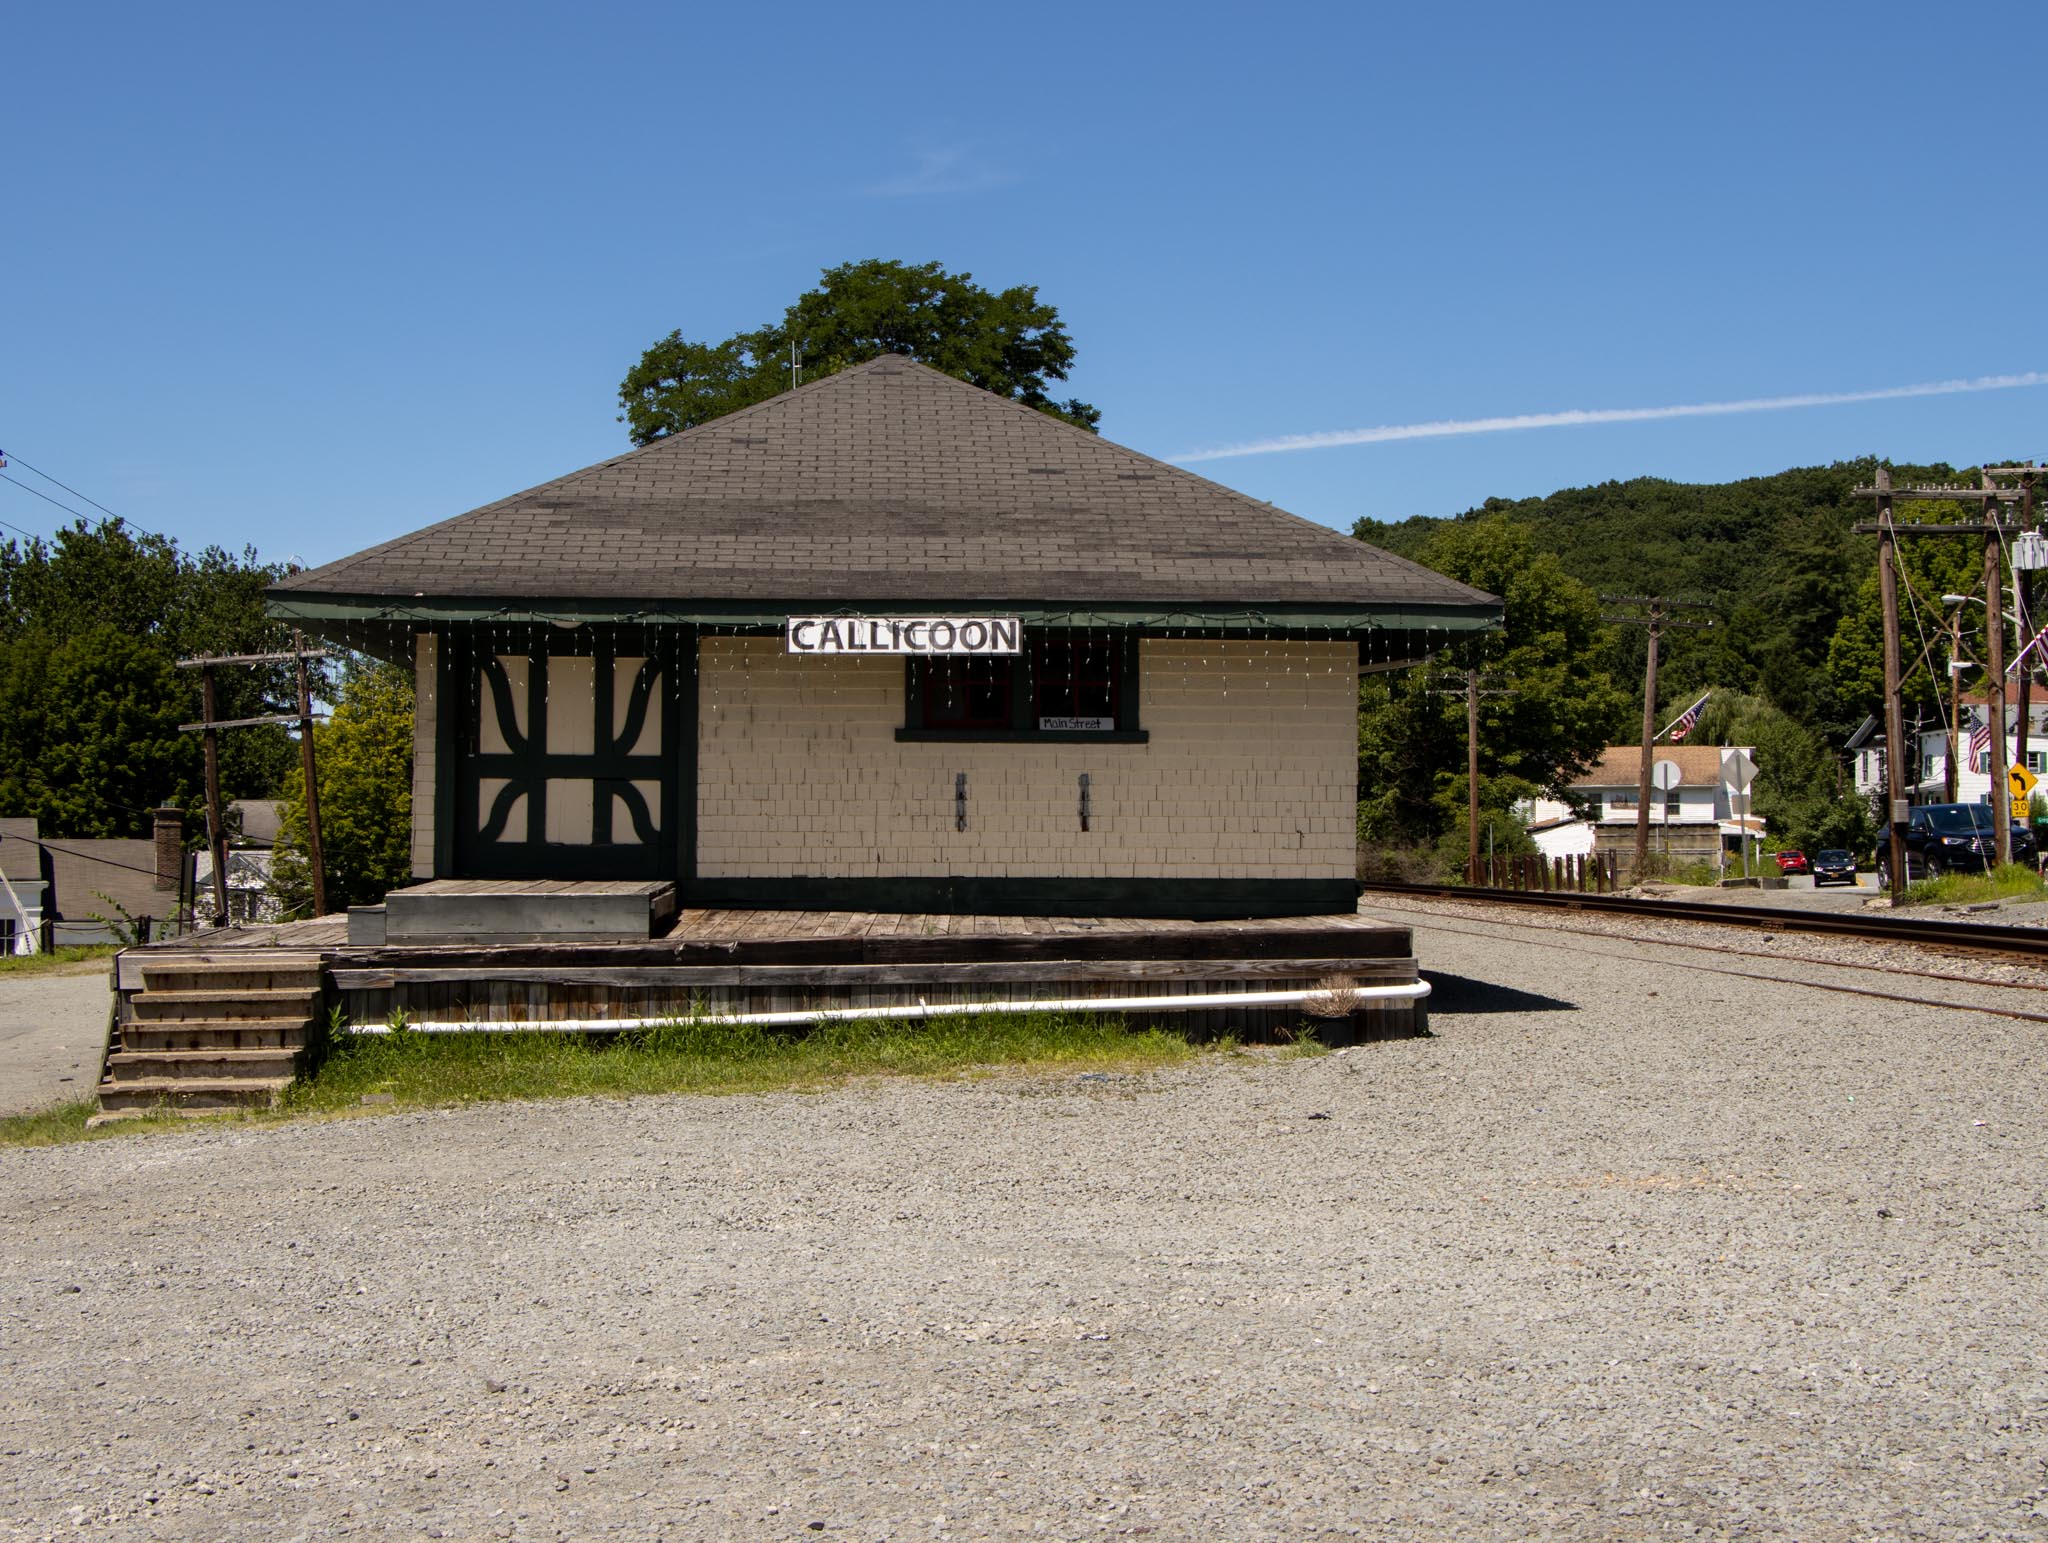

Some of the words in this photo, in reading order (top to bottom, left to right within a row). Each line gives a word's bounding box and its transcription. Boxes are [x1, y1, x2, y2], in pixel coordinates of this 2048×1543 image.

[791, 620, 1017, 651] CALLICOON
[1043, 718, 1067, 729] Main
[1068, 718, 1102, 729] Street
[2013, 802, 2027, 811] 30
